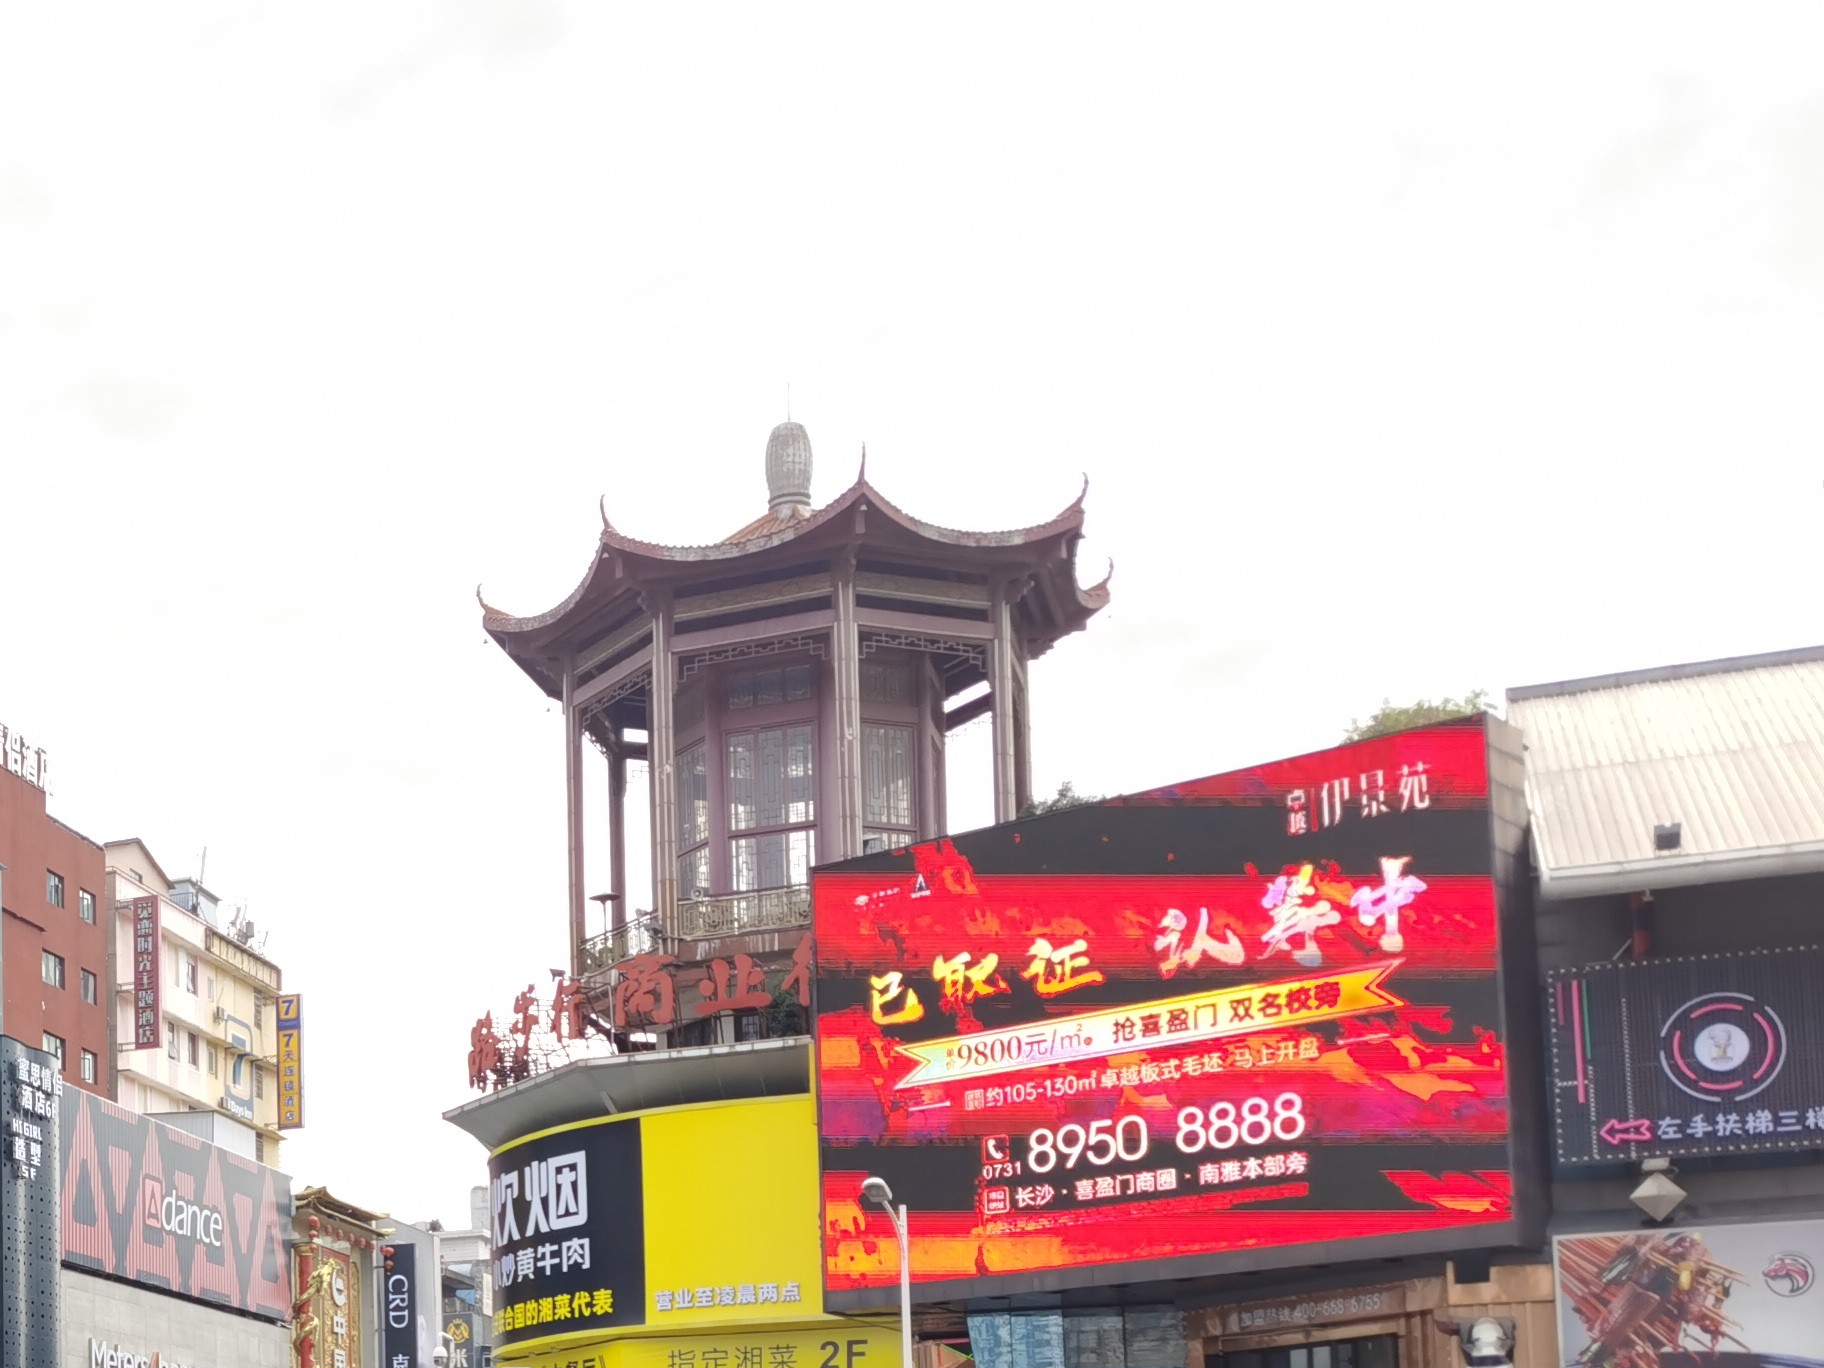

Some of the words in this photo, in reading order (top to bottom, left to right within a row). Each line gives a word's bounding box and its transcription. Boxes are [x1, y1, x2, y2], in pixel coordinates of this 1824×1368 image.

[281, 1000, 294, 1016] 7
[1112, 1001, 1218, 1043] 抢喜盈门
[1229, 981, 1340, 1024] 双名校旁
[1234, 1038, 1320, 1069] 马上开盘
[1028, 1114, 1148, 1174] 8950
[1176, 1091, 1306, 1154] 8888
[982, 1162, 1022, 1180] 0731
[388, 1274, 410, 1329] CRD
[654, 1281, 802, 1312] 营业至凌晨两点
